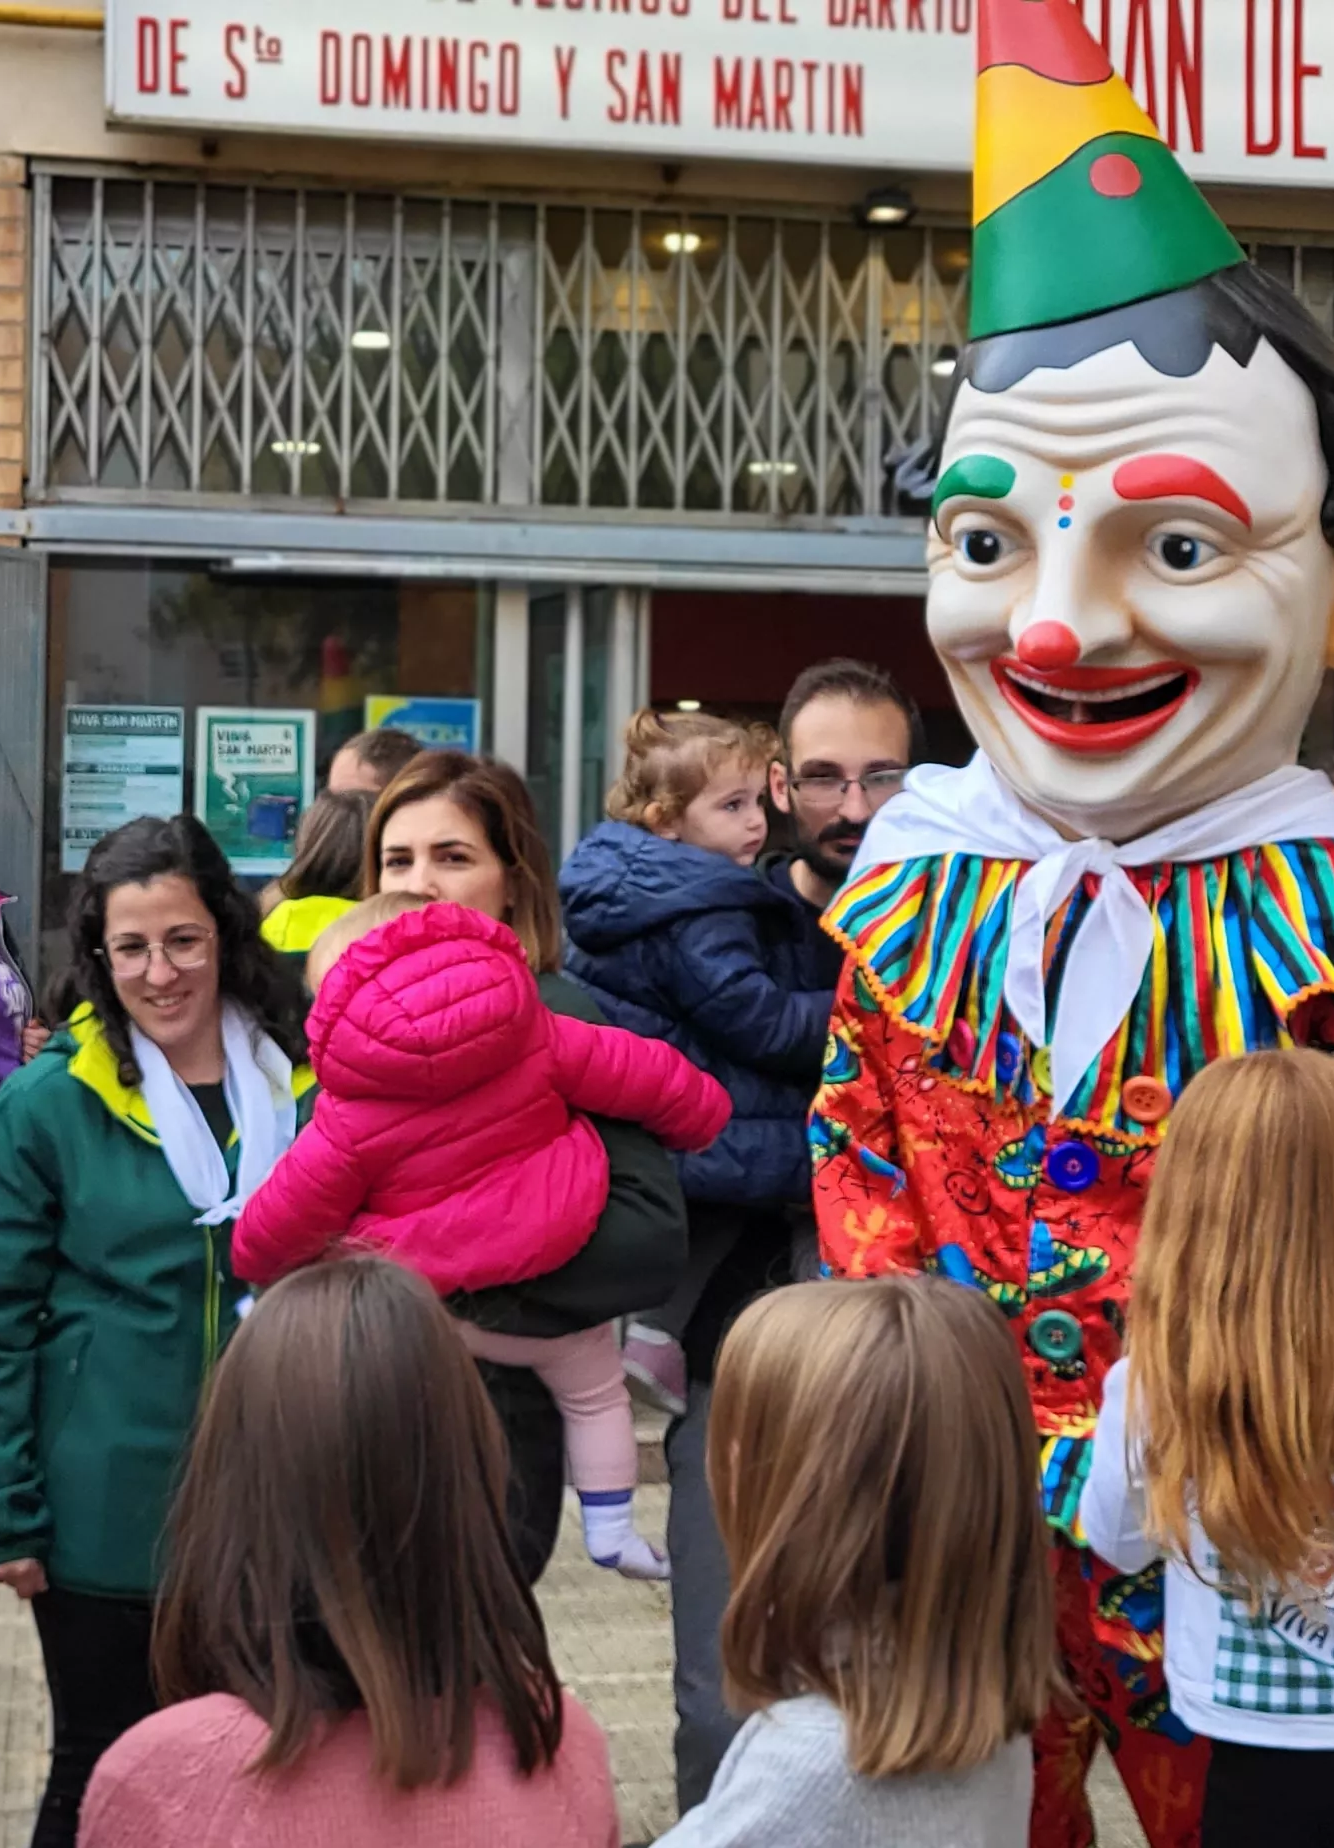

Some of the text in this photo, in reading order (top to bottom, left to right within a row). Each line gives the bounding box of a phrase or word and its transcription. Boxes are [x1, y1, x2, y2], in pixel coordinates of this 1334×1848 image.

[136, 17, 190, 96] DE
[319, 29, 520, 116] DOMINGO
[554, 45, 577, 121] Y
[606, 48, 682, 126] SAN
[713, 55, 865, 137] MARTIN
[1076, 0, 1204, 153] AN
[1245, 0, 1327, 160] DE
